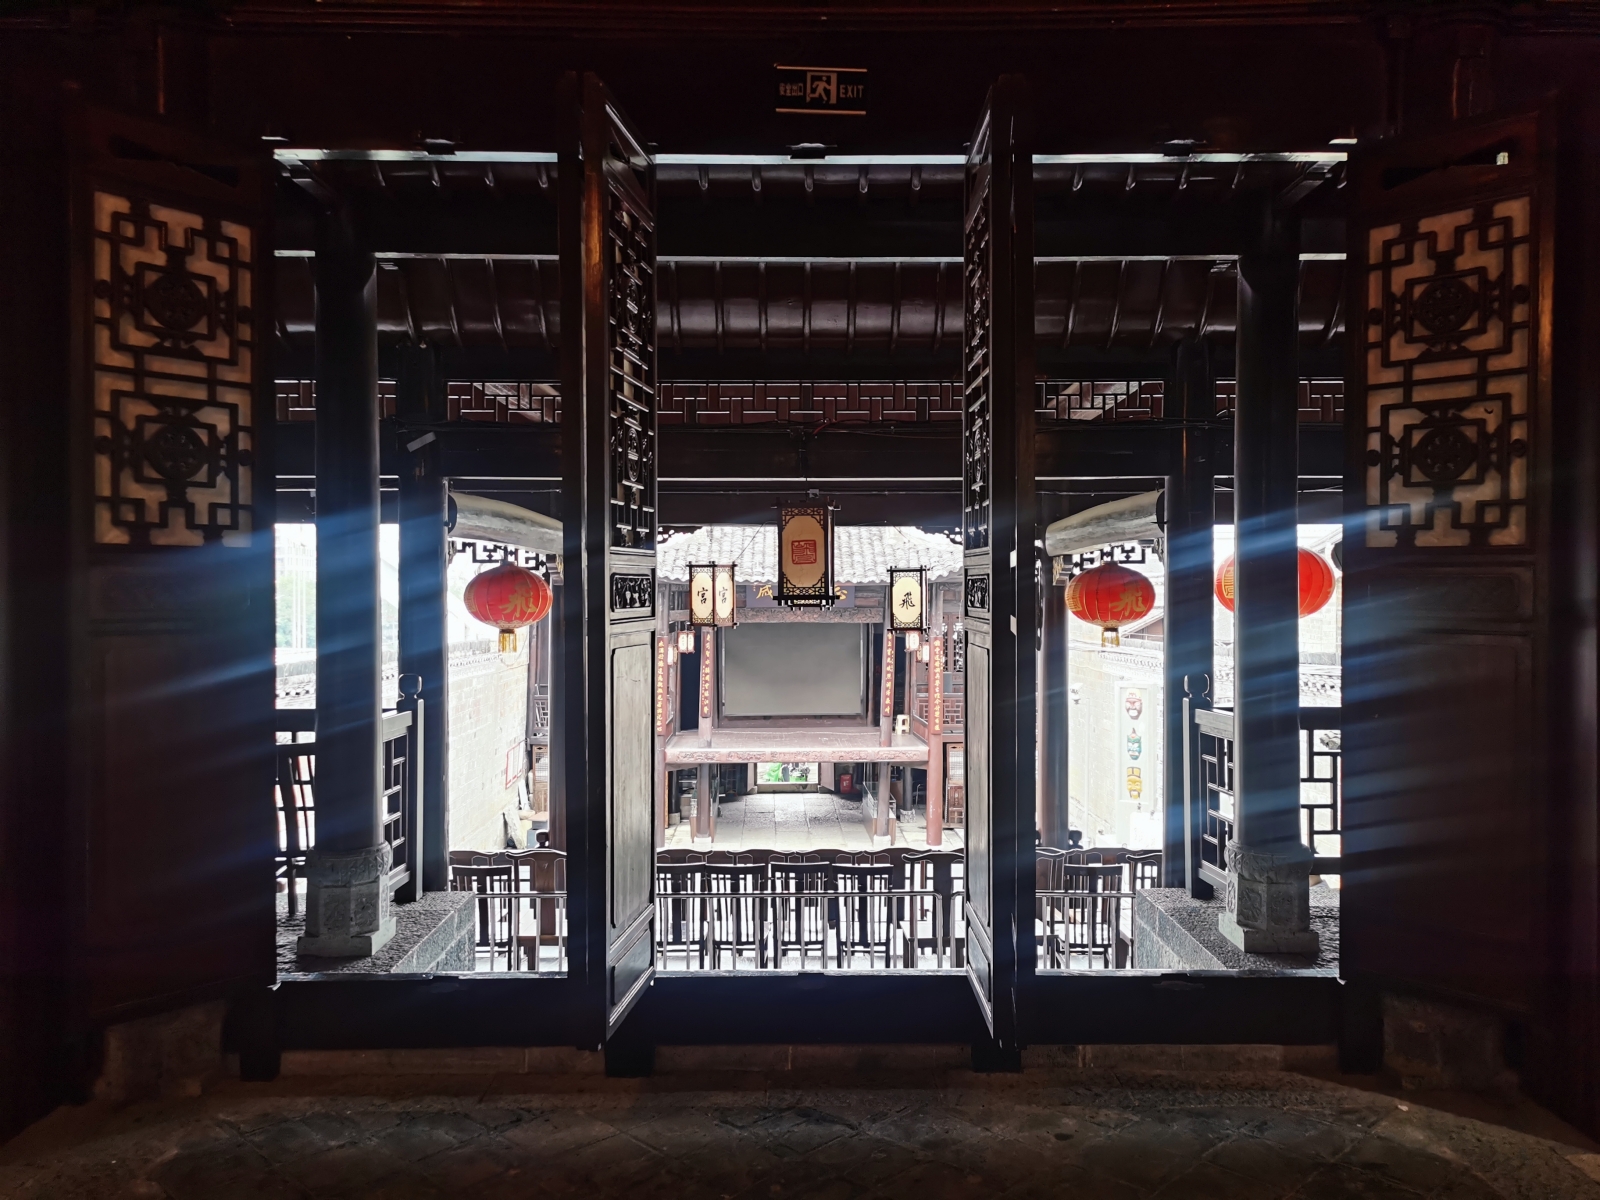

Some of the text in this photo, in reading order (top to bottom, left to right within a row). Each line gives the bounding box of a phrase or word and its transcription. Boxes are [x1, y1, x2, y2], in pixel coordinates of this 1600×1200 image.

[779, 83, 804, 96] 安全出口
[839, 84, 864, 98] EXIT
